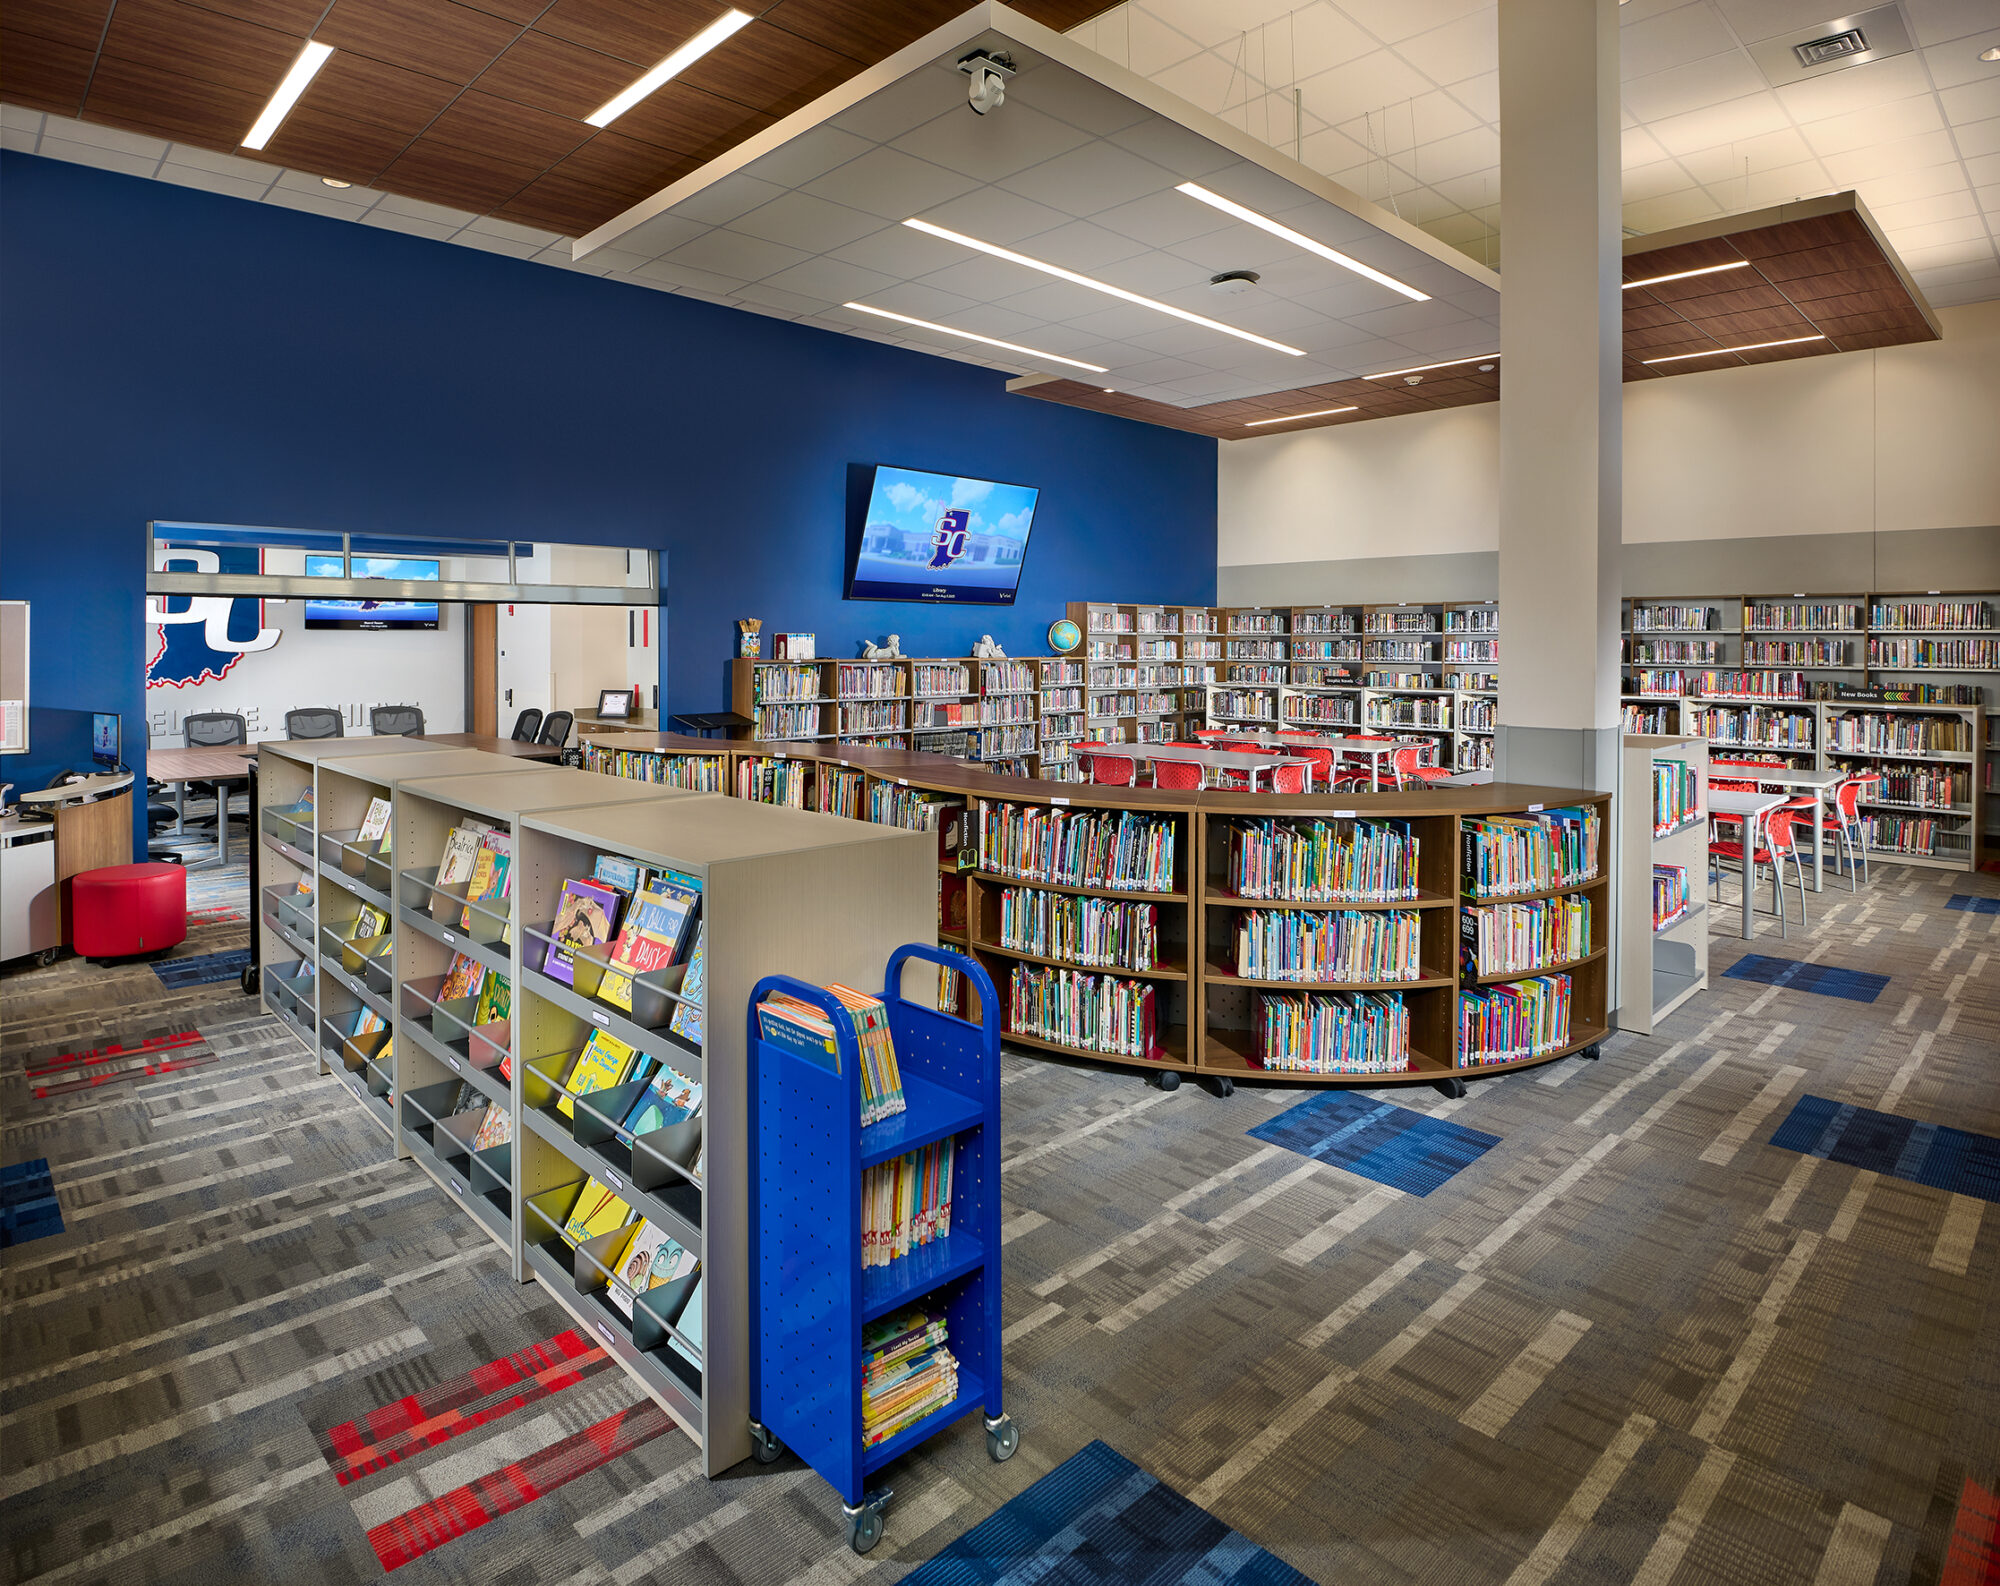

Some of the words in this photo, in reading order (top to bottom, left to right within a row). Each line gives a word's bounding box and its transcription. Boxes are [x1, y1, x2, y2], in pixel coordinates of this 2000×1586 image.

[931, 517, 971, 558] SC
[150, 706, 268, 736] ELIEVE.
[450, 831, 474, 855] Beatrice
[639, 908, 646, 924] A
[646, 910, 664, 932] BALL
[668, 917, 679, 934] FOR
[1461, 915, 1478, 926] 600-
[1462, 924, 1475, 936] 699
[635, 940, 667, 971] DAISY
